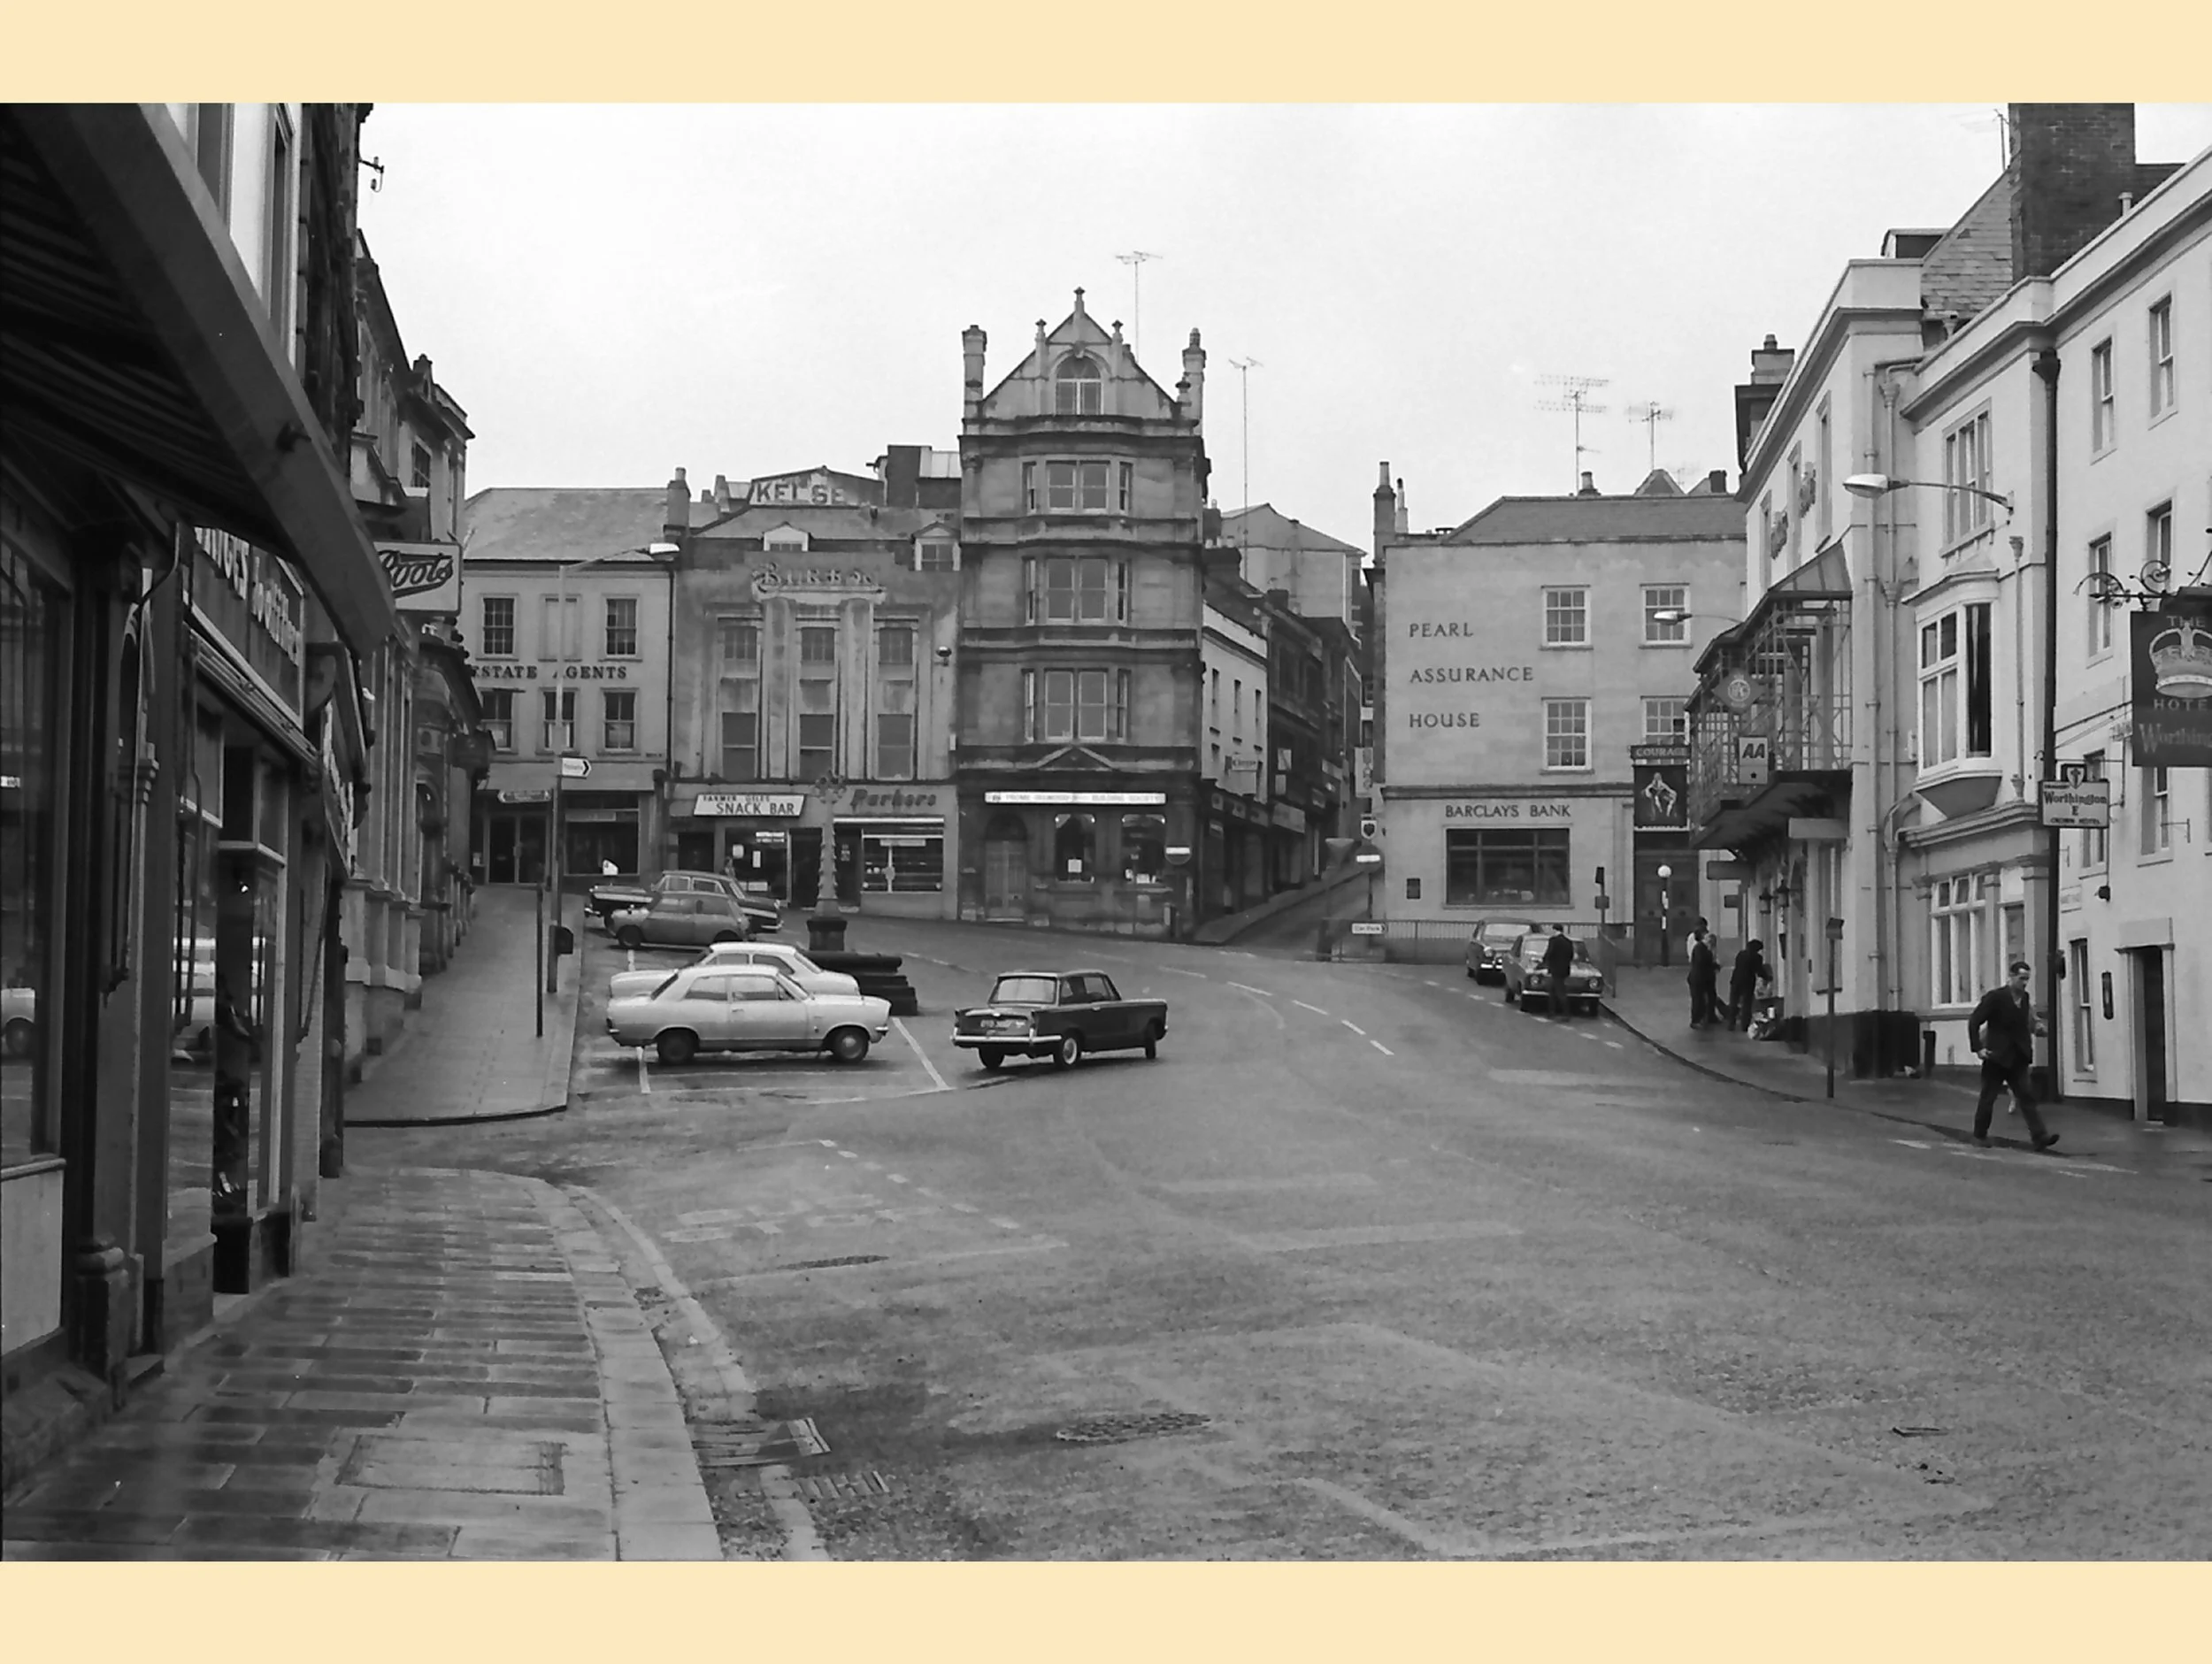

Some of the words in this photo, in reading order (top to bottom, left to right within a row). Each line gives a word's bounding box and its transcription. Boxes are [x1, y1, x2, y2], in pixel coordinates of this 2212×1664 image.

[2166, 616, 2205, 627] THE
[1409, 623, 1474, 638] PEARL
[552, 665, 626, 679] GENTS
[1409, 667, 1533, 683] ASSURANCE
[1409, 712, 1480, 728] HOUSE
[1741, 743, 1765, 759] AA
[2044, 791, 2107, 805] Worthington
[716, 802, 761, 815] SNACK
[769, 802, 795, 815] BAR
[1445, 804, 1520, 817] BARCLAYS
[1530, 804, 1571, 817] BANK
